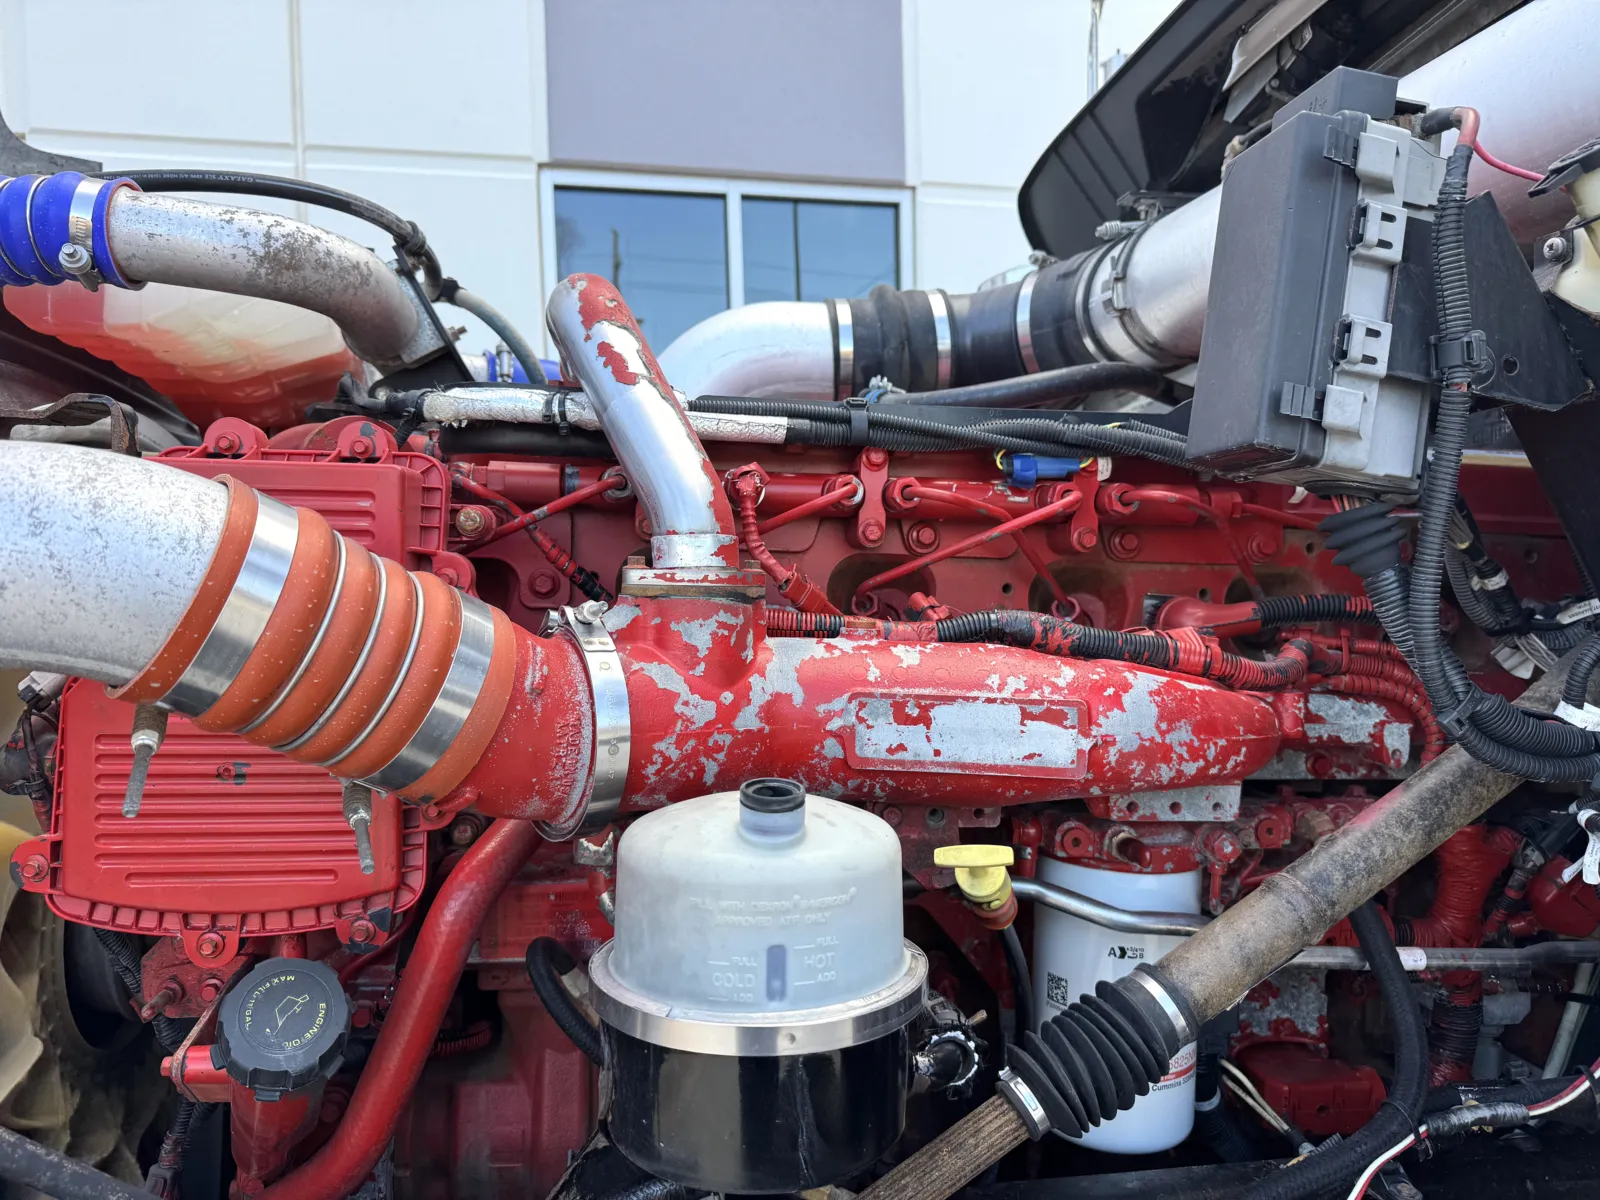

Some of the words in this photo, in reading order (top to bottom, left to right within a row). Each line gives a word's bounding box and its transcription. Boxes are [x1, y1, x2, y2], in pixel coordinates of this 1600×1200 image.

[218, 174, 253, 183] GALAXY
[718, 899, 746, 911] WITH
[714, 913, 774, 927] APPROVED
[778, 914, 801, 926] ATF
[804, 911, 832, 925] ONLY
[816, 935, 840, 948] FULL
[1107, 946, 1117, 958] A
[731, 955, 759, 967] FULL
[803, 951, 836, 969] HOT
[272, 975, 295, 983] MAX
[711, 971, 756, 988] COLD
[816, 970, 837, 983] ADD
[731, 993, 755, 1003] ADD
[304, 1002, 327, 1040] ENGINE
[282, 1038, 301, 1048] OIL
[1151, 1080, 1182, 1092] Cummins
